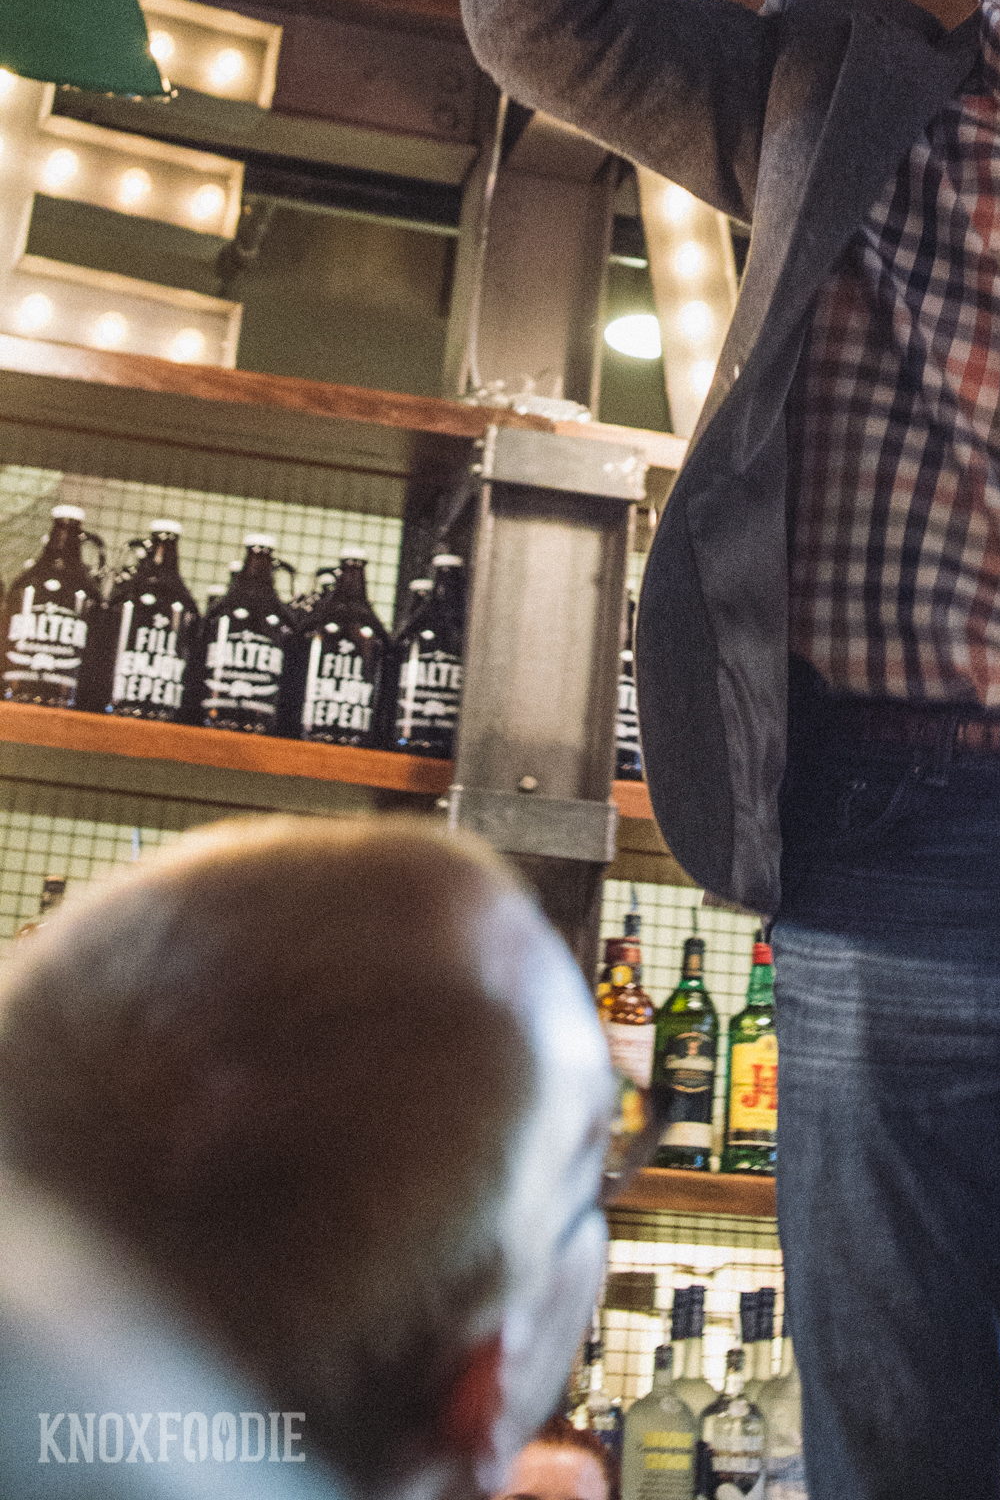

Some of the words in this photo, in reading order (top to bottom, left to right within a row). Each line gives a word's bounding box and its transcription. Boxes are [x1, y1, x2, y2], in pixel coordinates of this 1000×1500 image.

[135, 626, 178, 657] FILL
[117, 650, 187, 683] ENJOY
[321, 652, 364, 680] FILL
